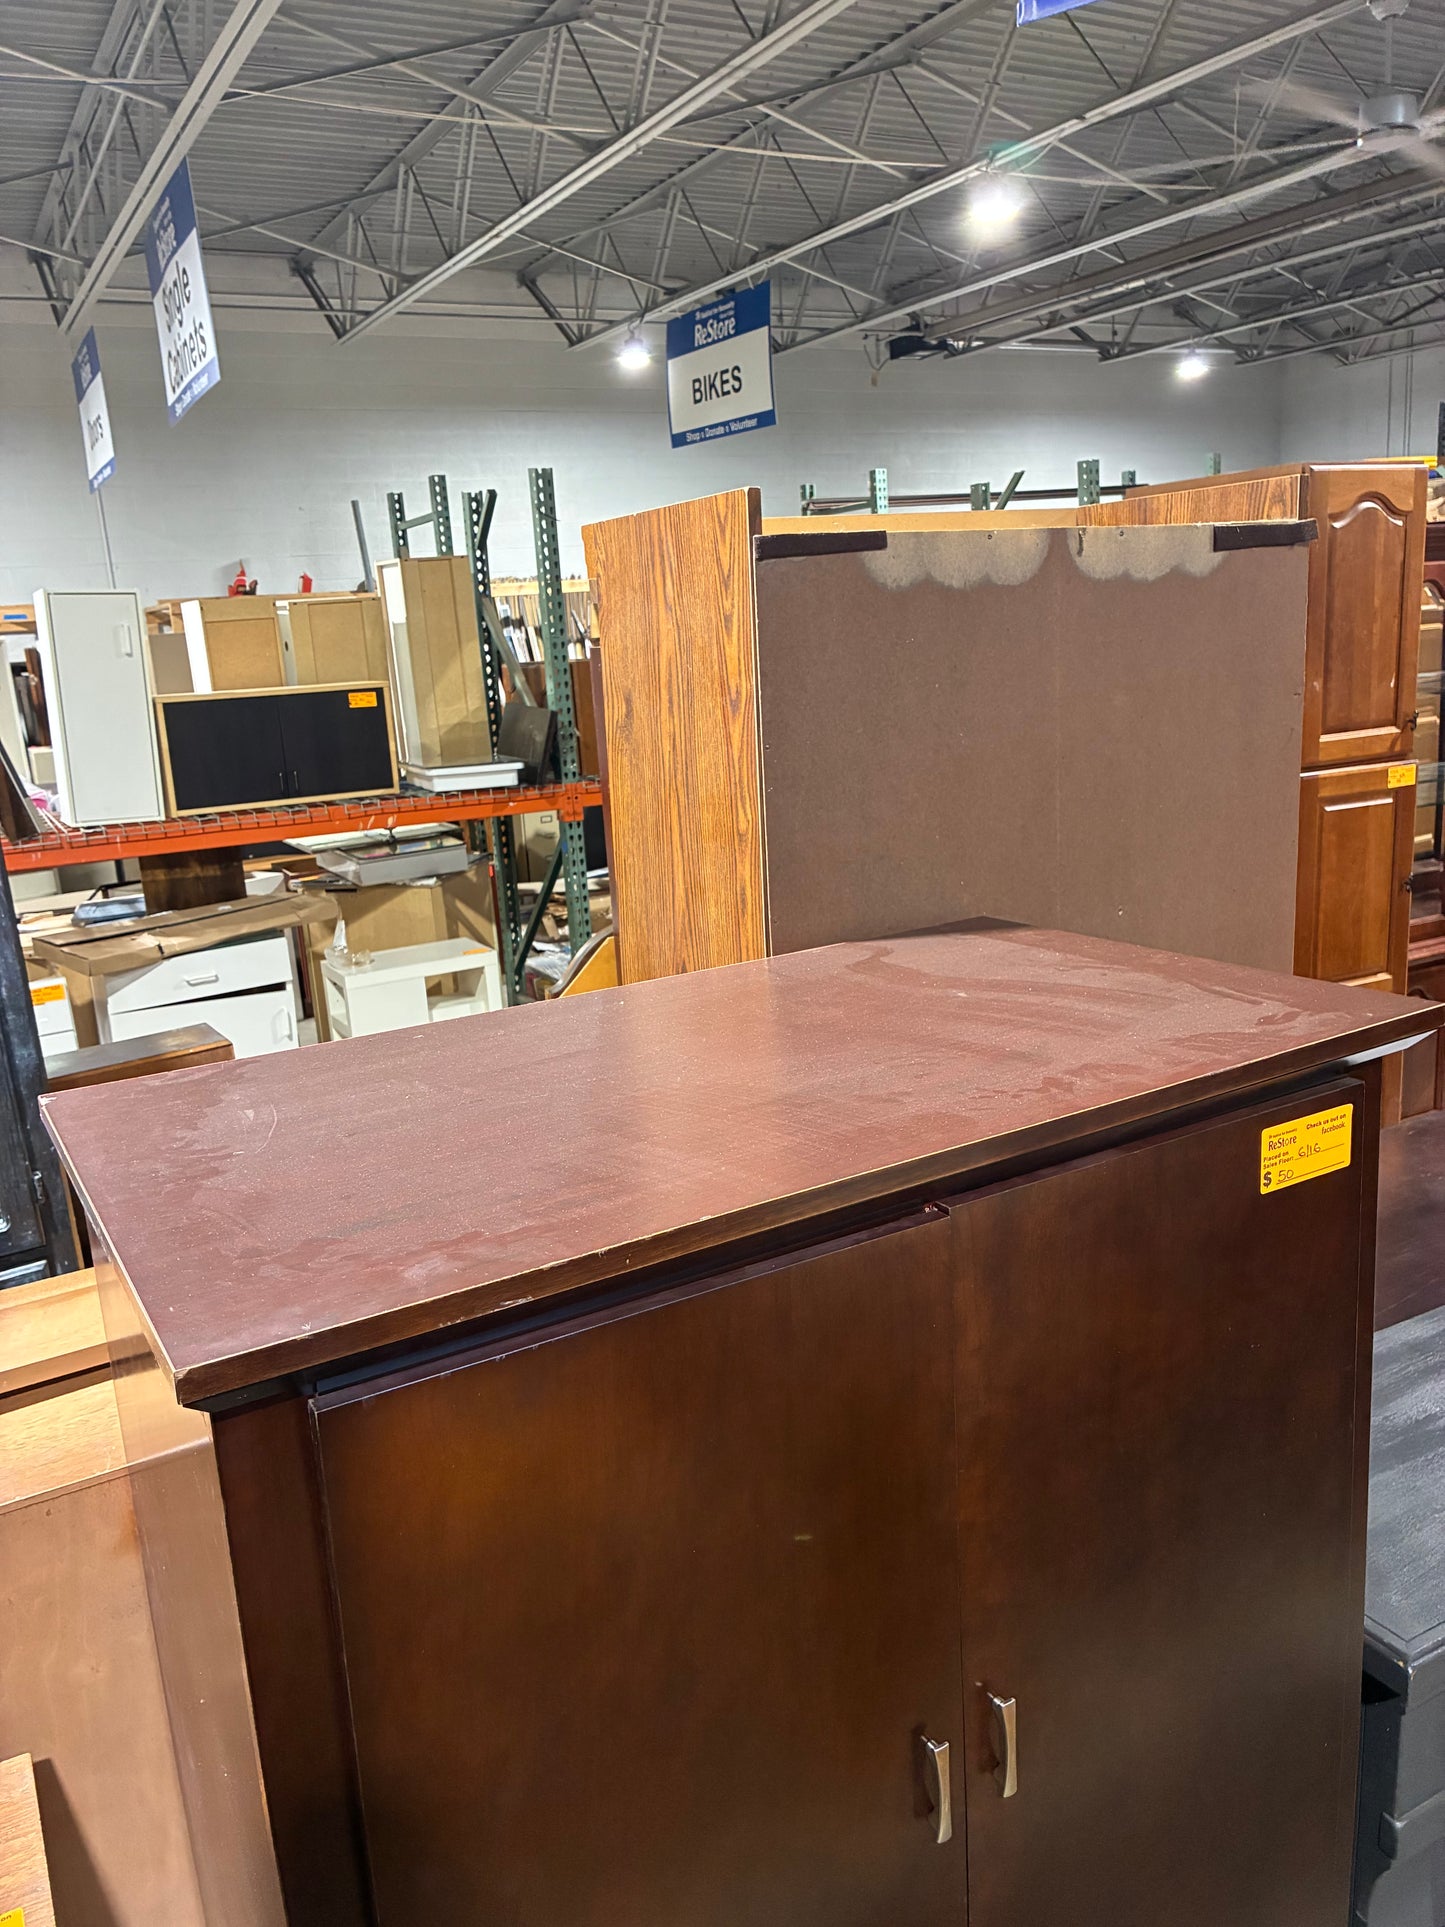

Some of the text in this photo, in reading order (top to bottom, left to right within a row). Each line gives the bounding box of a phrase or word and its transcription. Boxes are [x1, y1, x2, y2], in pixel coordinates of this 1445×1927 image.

[162, 259, 191, 334] Single
[694, 317, 736, 347] ReStore
[167, 315, 207, 395] Cabinets
[692, 365, 743, 405] BIKES
[1306, 1120, 1322, 1130] Check
[1322, 1117, 1329, 1125] us
[1330, 1115, 1339, 1123] out
[1321, 1121, 1346, 1135] facebook
[1268, 1135, 1297, 1152] ReStore
[1263, 1152, 1282, 1163] Placed
[1263, 1160, 1278, 1170] Sales
[1278, 1156, 1294, 1165] Floor:
[1263, 1169, 1294, 1188] $ 50
